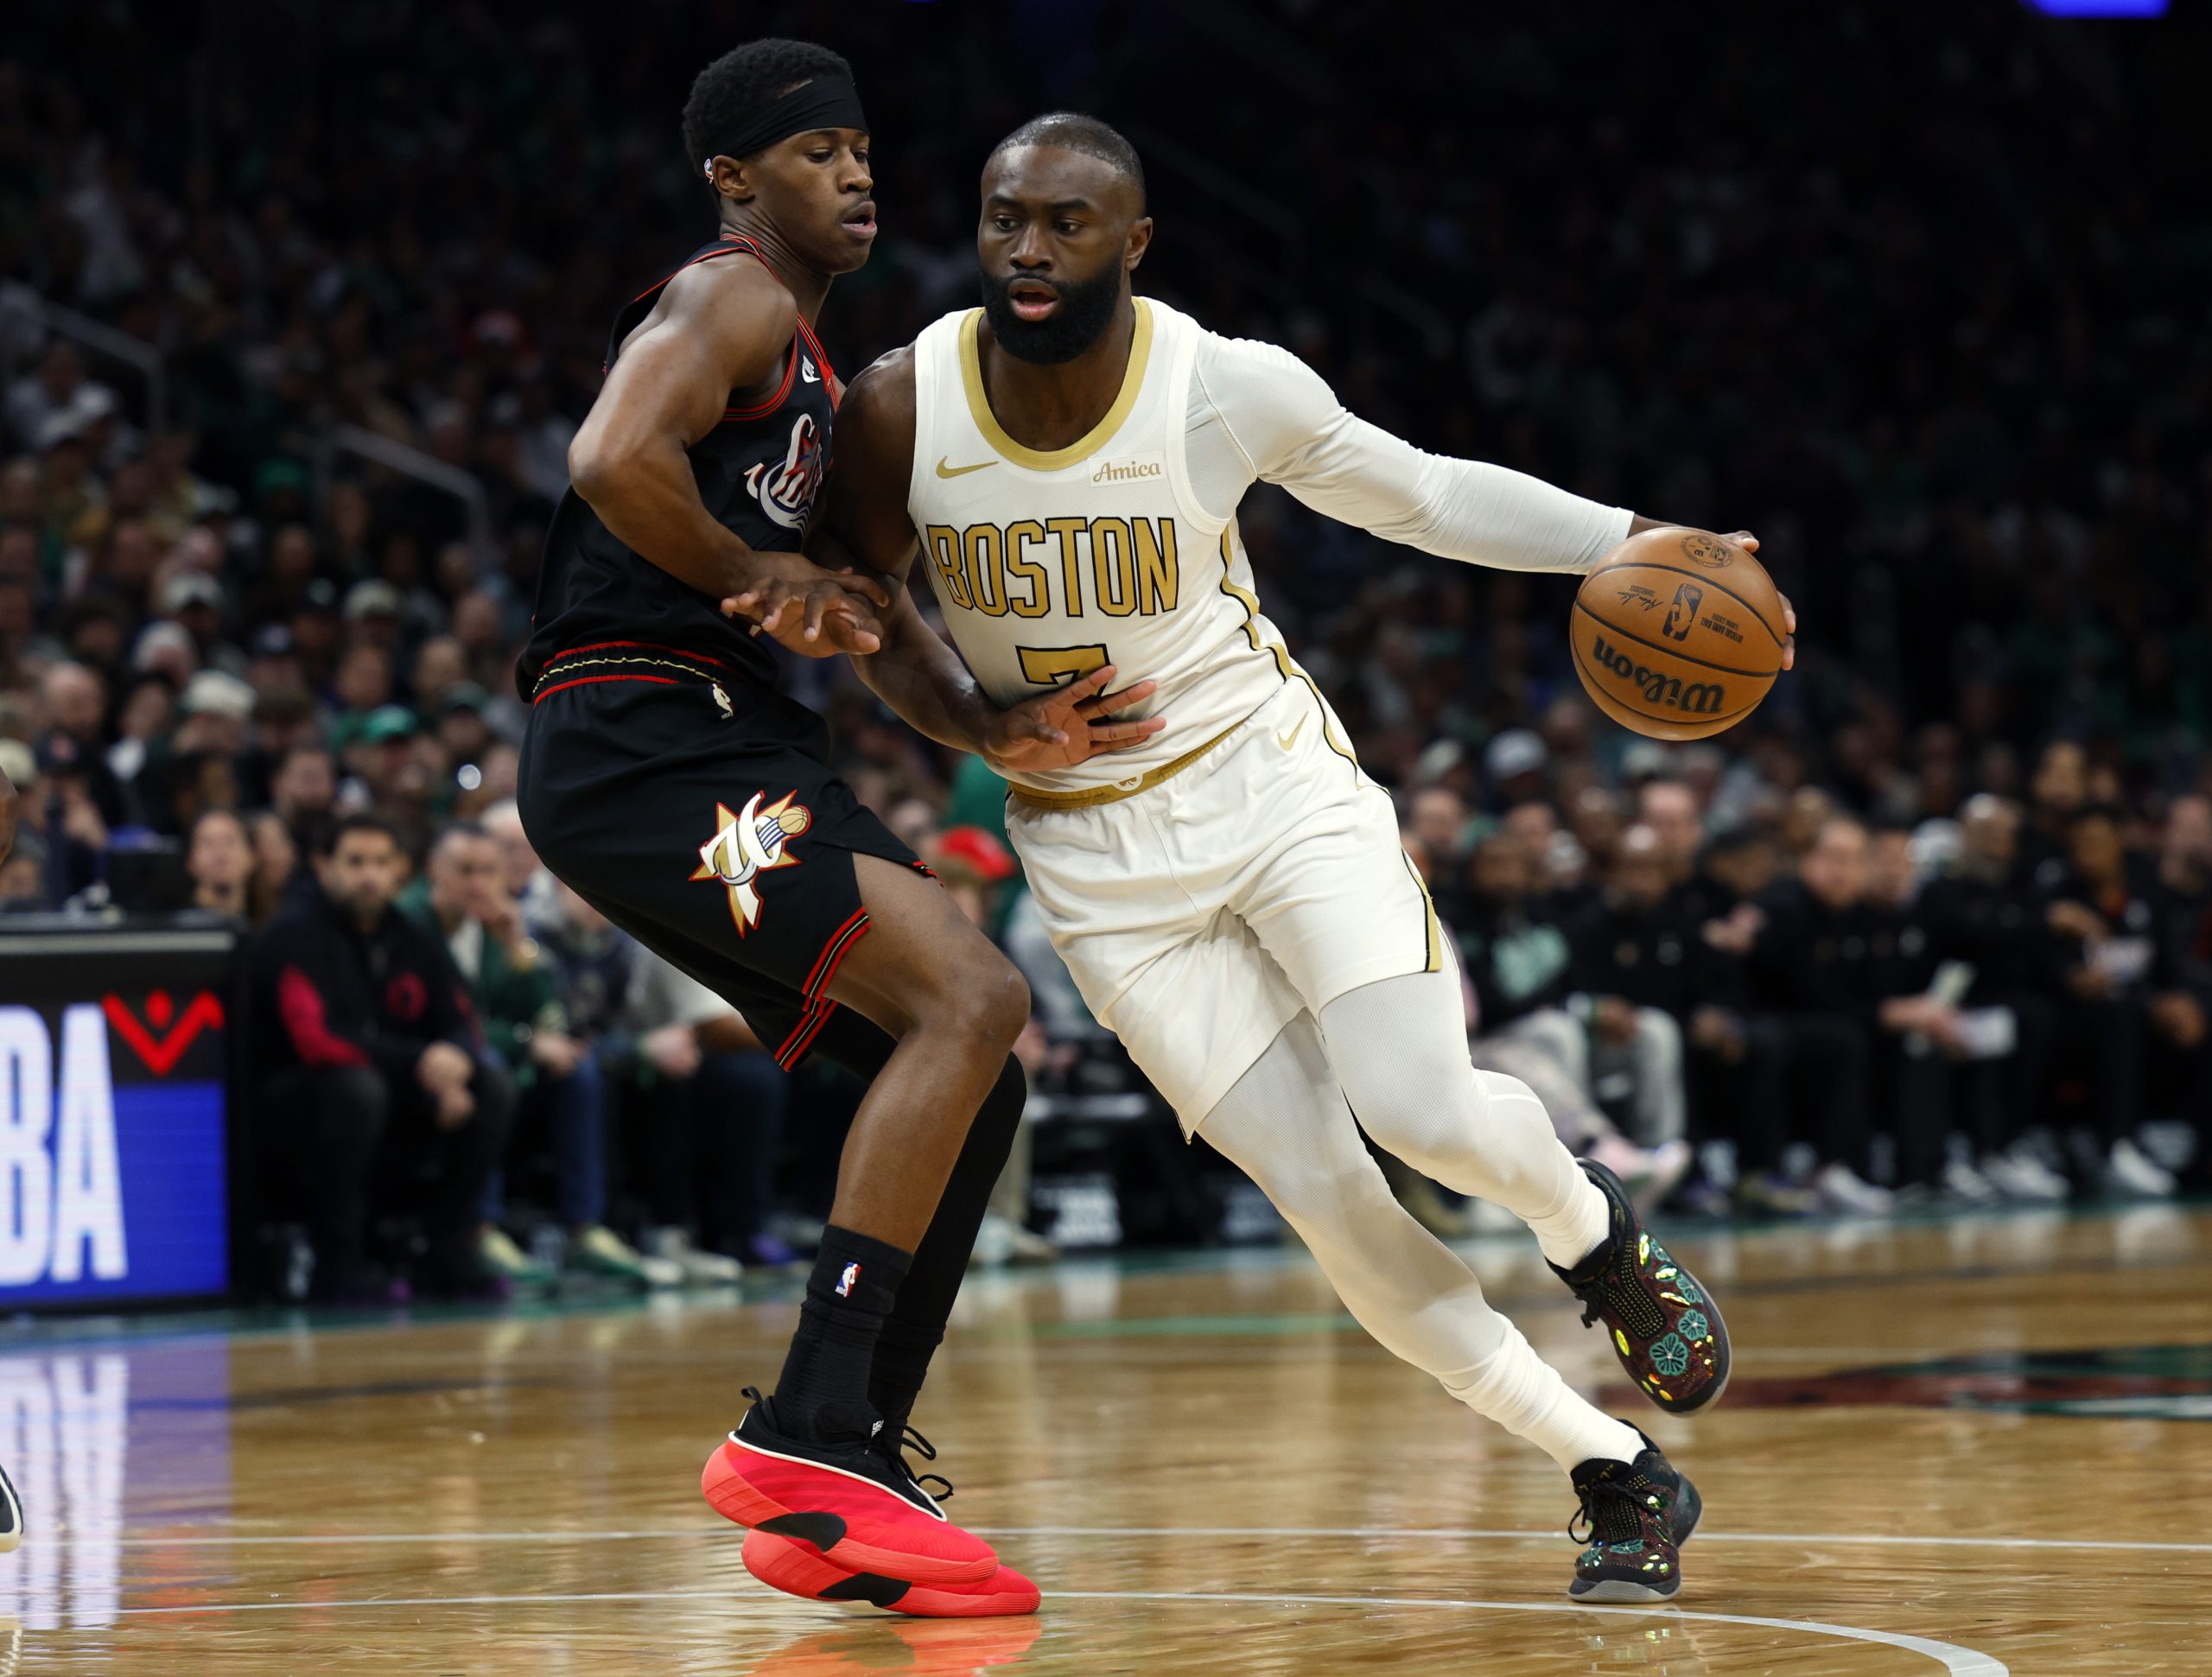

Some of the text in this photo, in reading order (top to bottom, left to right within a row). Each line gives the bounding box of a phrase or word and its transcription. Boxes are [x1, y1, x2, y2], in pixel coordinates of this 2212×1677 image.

[1093, 461, 1161, 482] Amica
[926, 517, 1179, 619] BOSTON
[1015, 644, 1112, 713] 7
[1592, 635, 1725, 714] Wilson
